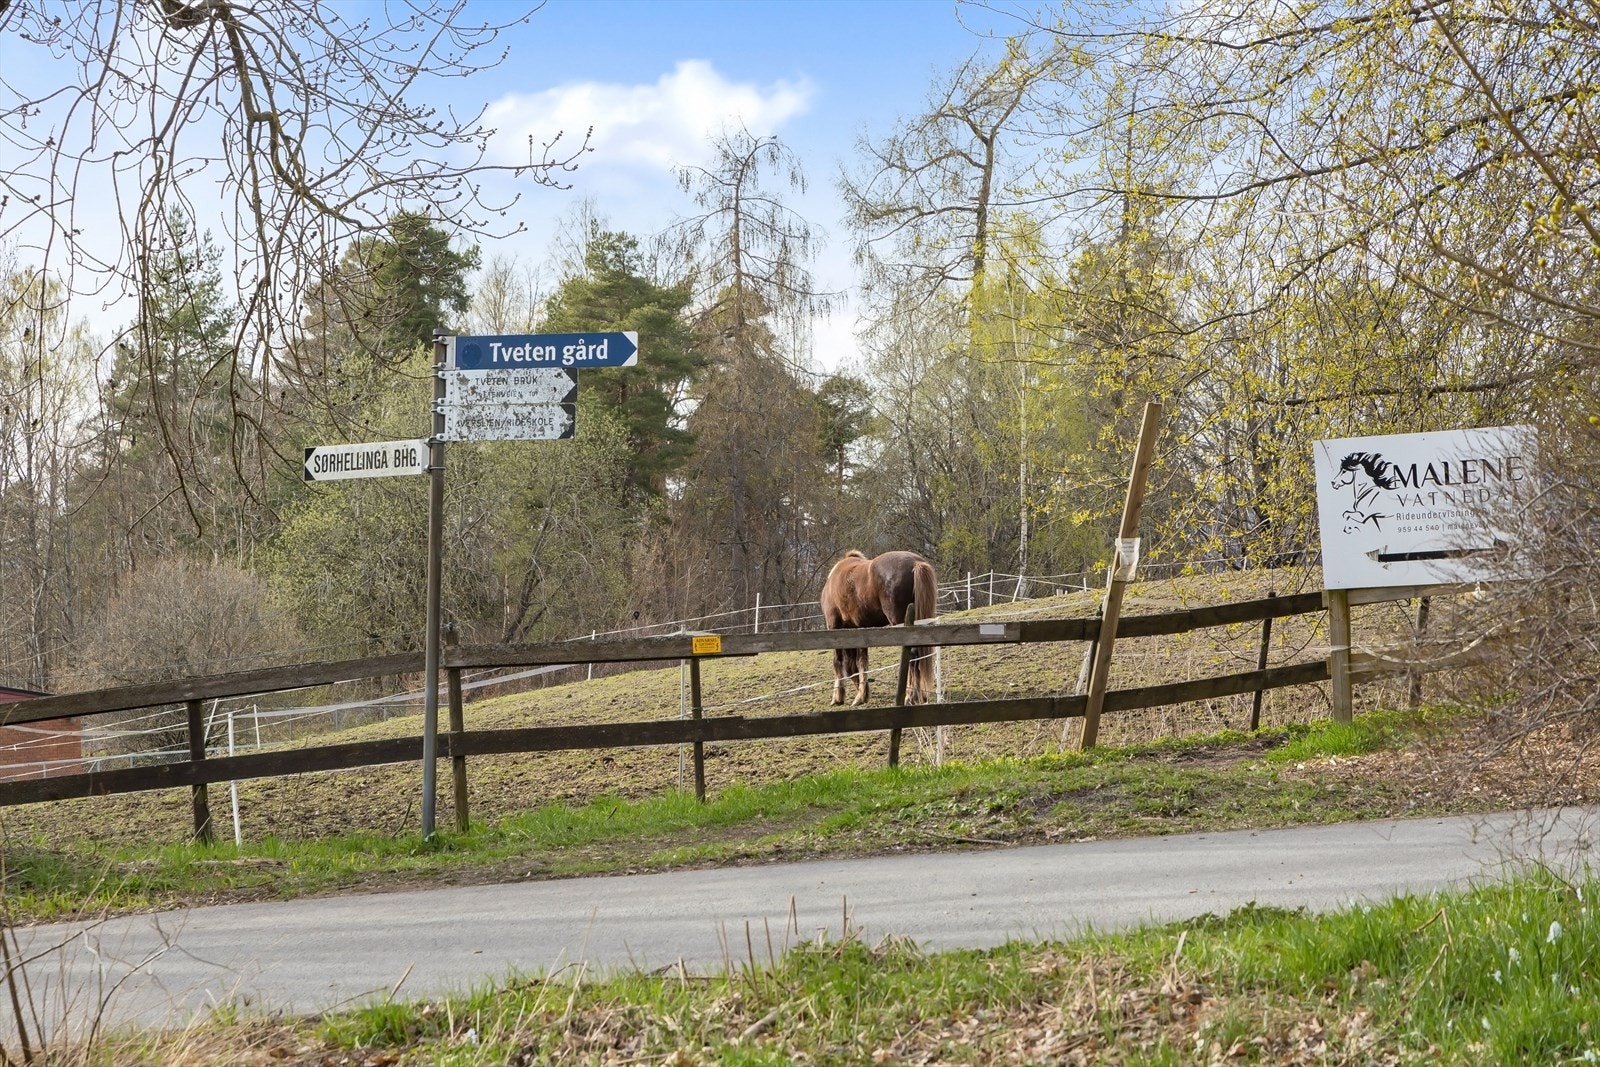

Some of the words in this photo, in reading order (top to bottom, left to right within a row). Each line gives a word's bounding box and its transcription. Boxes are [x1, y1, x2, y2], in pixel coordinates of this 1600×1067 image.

[489, 341, 556, 363] Tveten
[562, 338, 609, 366] gård
[475, 376, 508, 386] TVETEN
[513, 375, 538, 385] BRUK
[313, 450, 388, 474] SØRHELLINGA
[394, 447, 421, 468] BHG.
[1393, 456, 1524, 489] MALENE
[1396, 508, 1476, 521] Rideundervisning
[1397, 526, 1412, 534] 959
